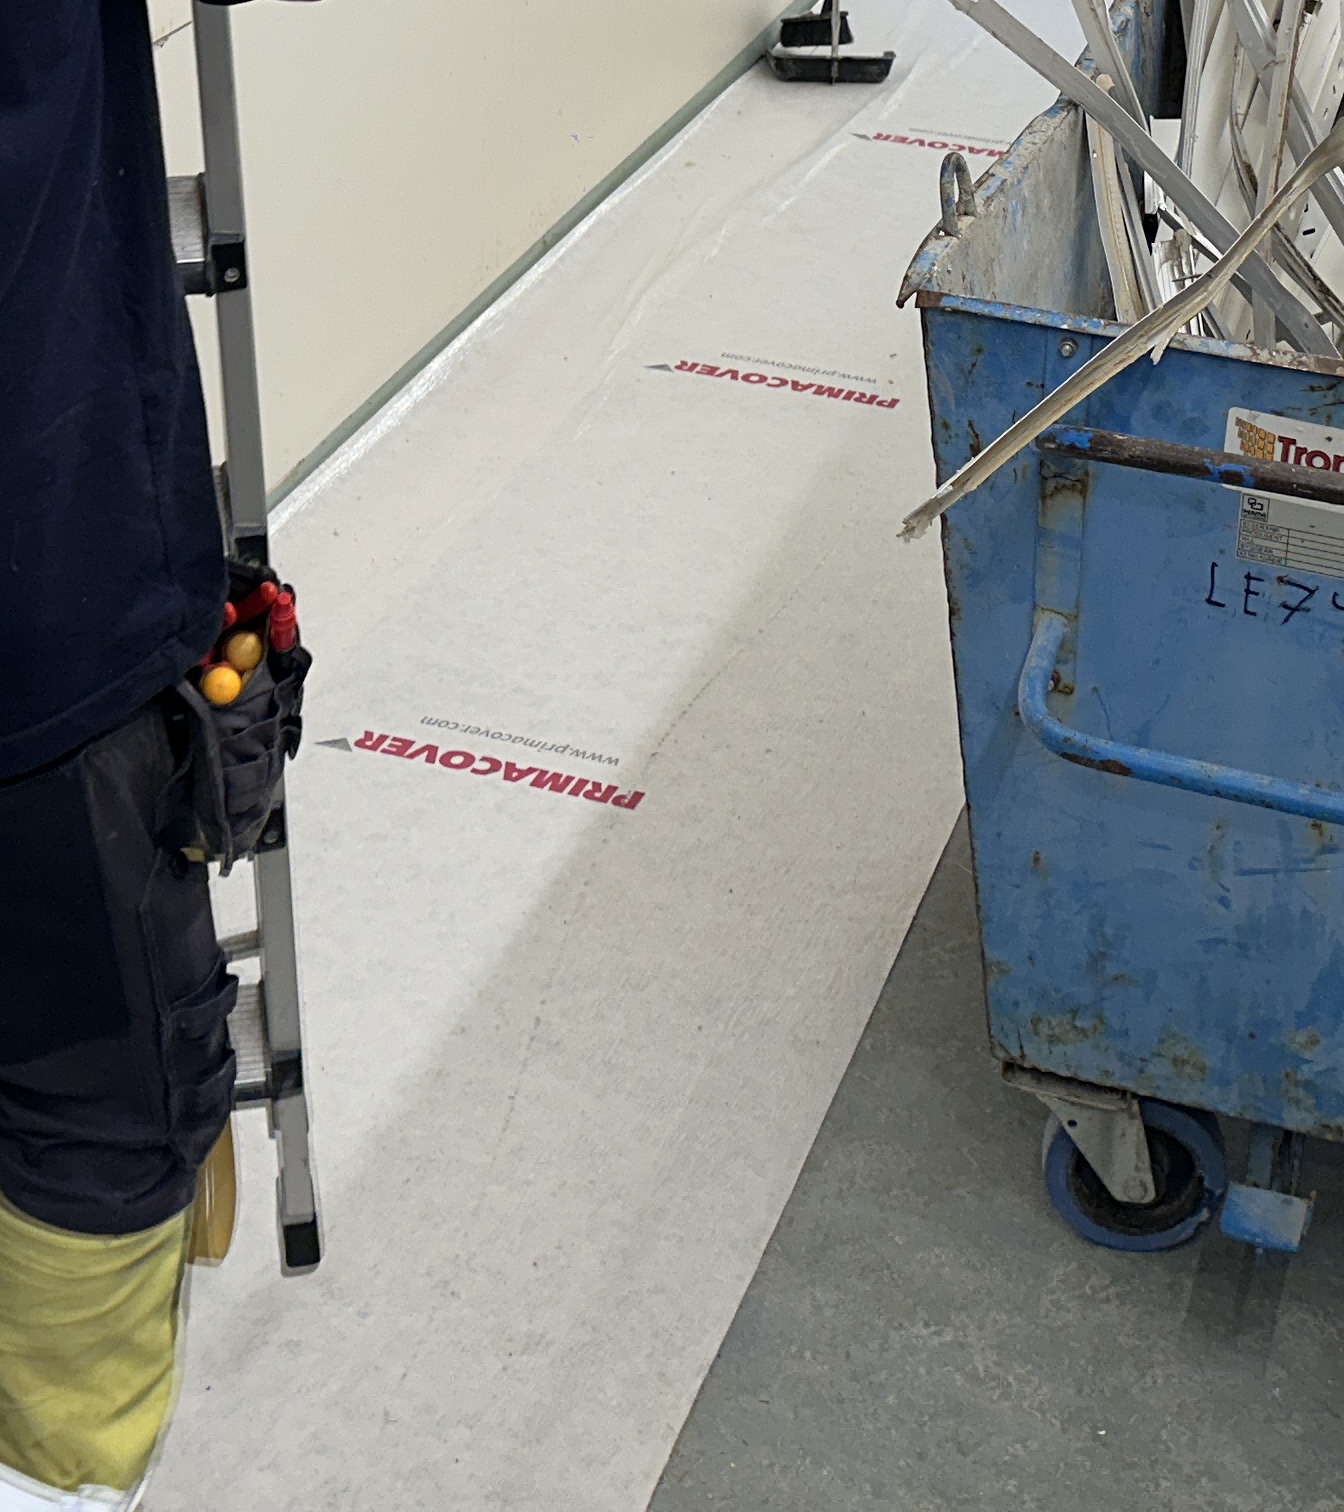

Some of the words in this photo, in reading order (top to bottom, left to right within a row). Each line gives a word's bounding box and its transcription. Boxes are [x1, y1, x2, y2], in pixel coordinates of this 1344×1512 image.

[674, 360, 901, 409] PRIMACOVER
[419, 715, 621, 767] www.primacover.com
[353, 730, 646, 810] PRIMACOVER
